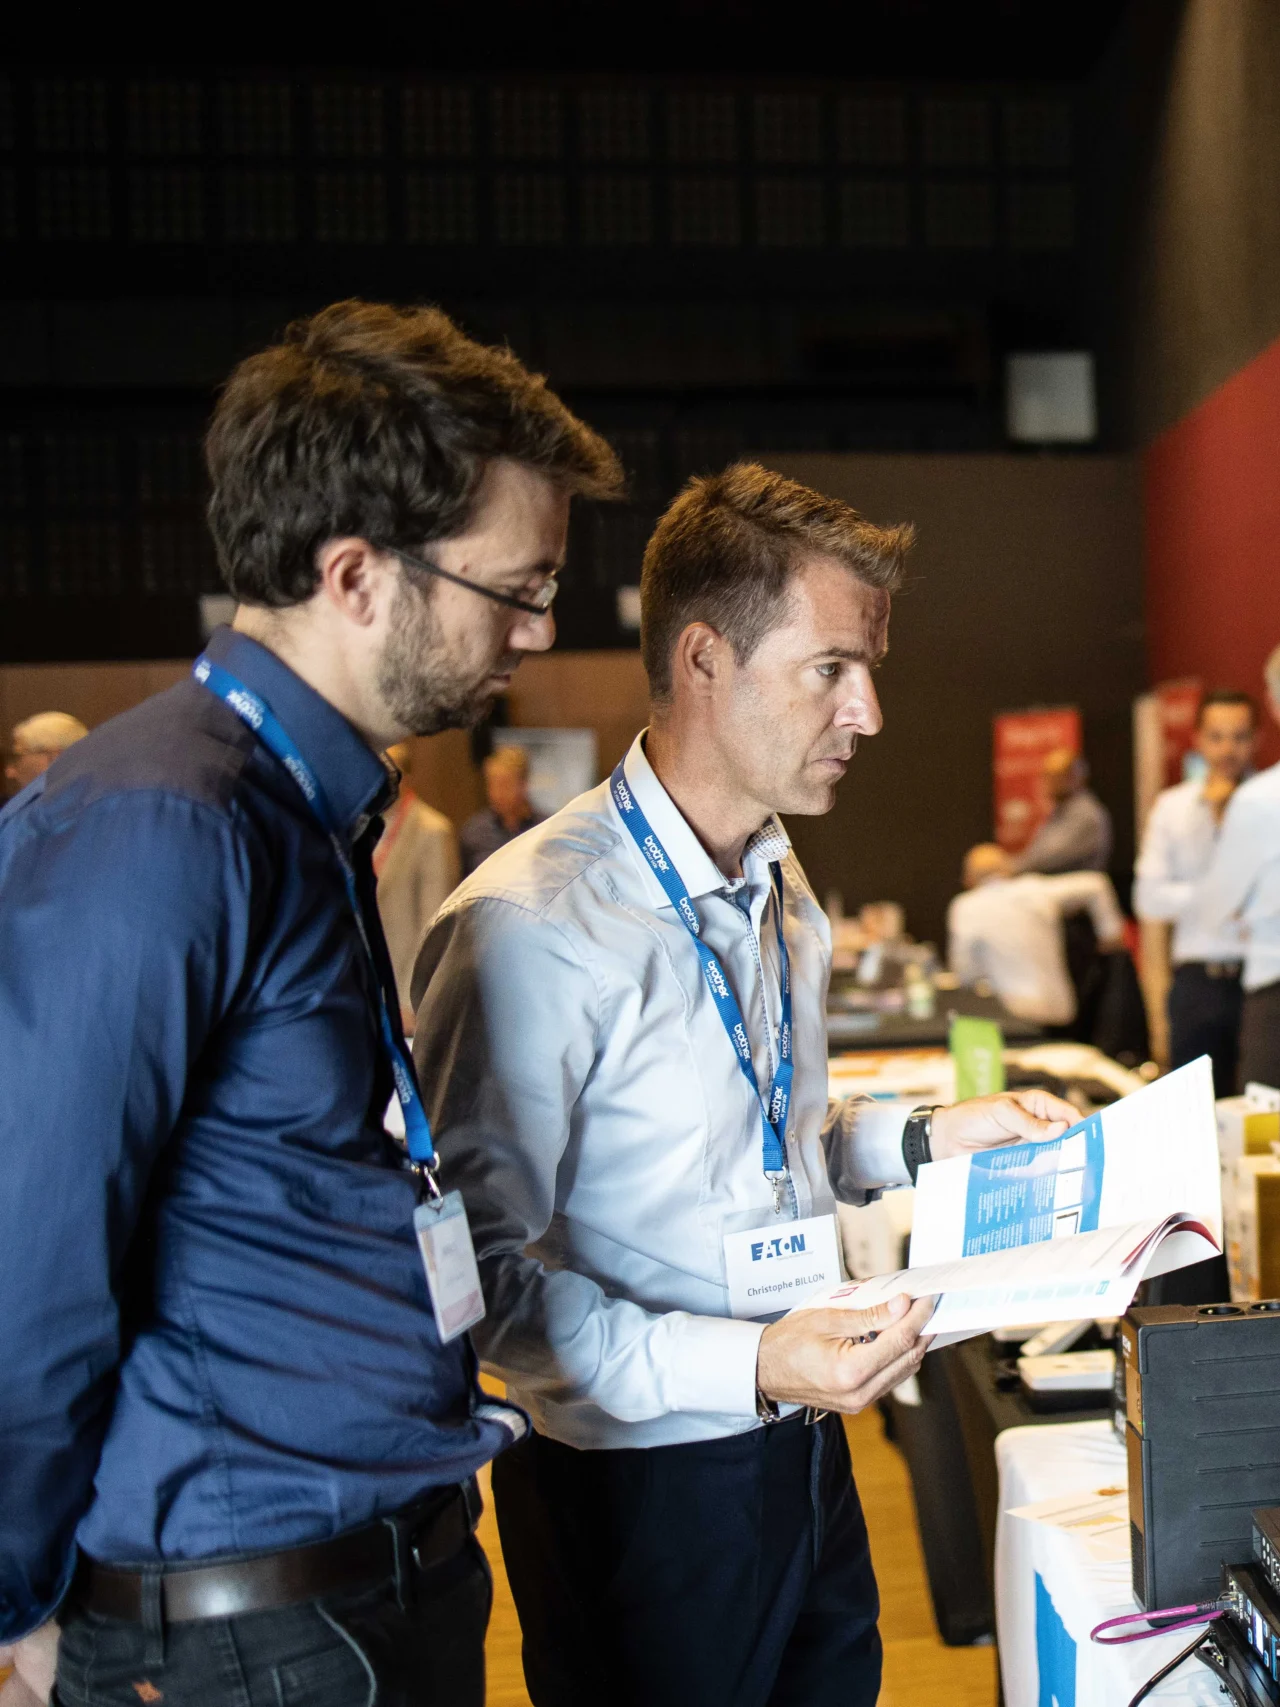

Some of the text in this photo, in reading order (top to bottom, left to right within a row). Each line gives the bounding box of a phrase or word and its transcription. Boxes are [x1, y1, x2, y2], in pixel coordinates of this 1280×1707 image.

[616, 780, 634, 811] brother
[644, 835, 670, 871] brother
[680, 897, 700, 934] brother
[708, 961, 729, 998] brother
[734, 1023, 751, 1059] brother
[770, 1087, 783, 1123] brother
[751, 1233, 806, 1262] EATON
[747, 1273, 825, 1297] Christophe BILLON
